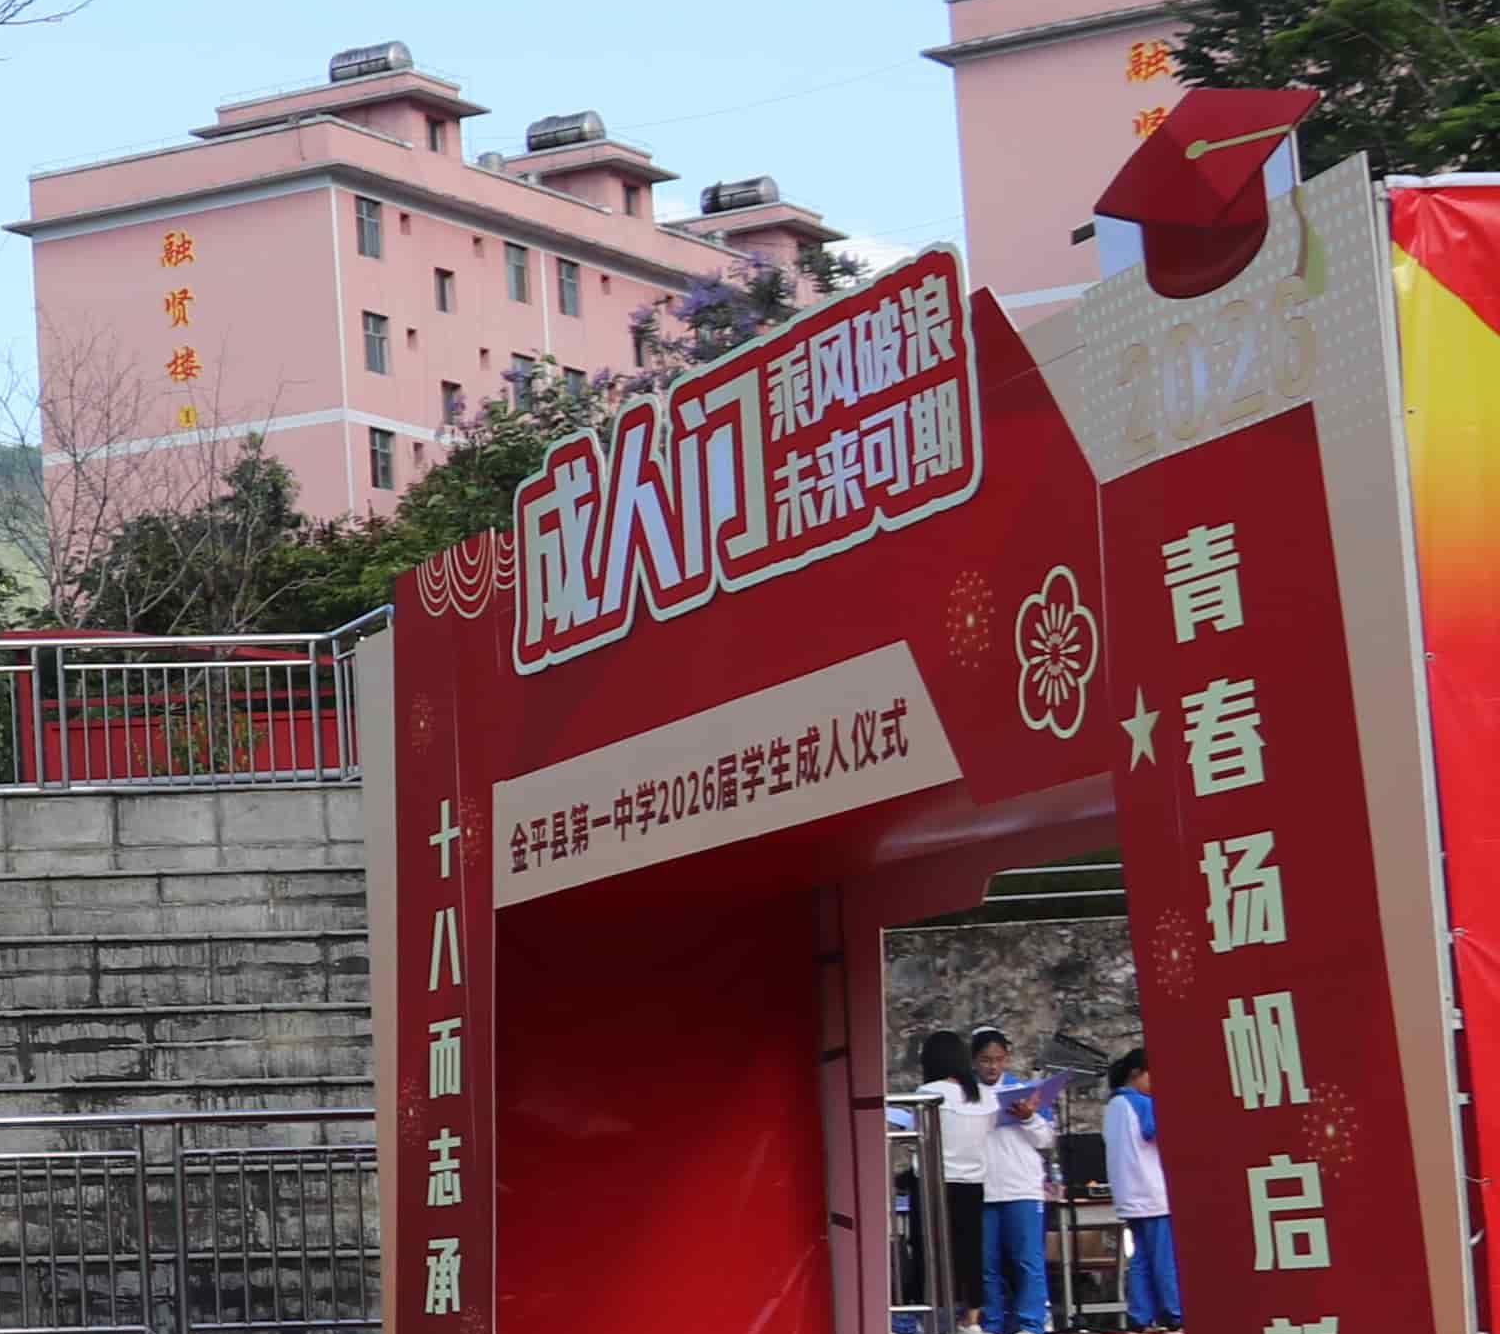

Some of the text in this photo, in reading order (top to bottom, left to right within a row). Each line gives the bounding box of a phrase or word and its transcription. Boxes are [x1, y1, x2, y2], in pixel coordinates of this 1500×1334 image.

[160, 228, 202, 383] 融贤楼
[767, 273, 957, 442] 乘风破浪
[1114, 273, 1318, 466] 2026
[522, 366, 770, 648] 成人门
[771, 377, 965, 542] 未来可期
[508, 697, 910, 875] 金平县第一中学2026届学生成人仪式
